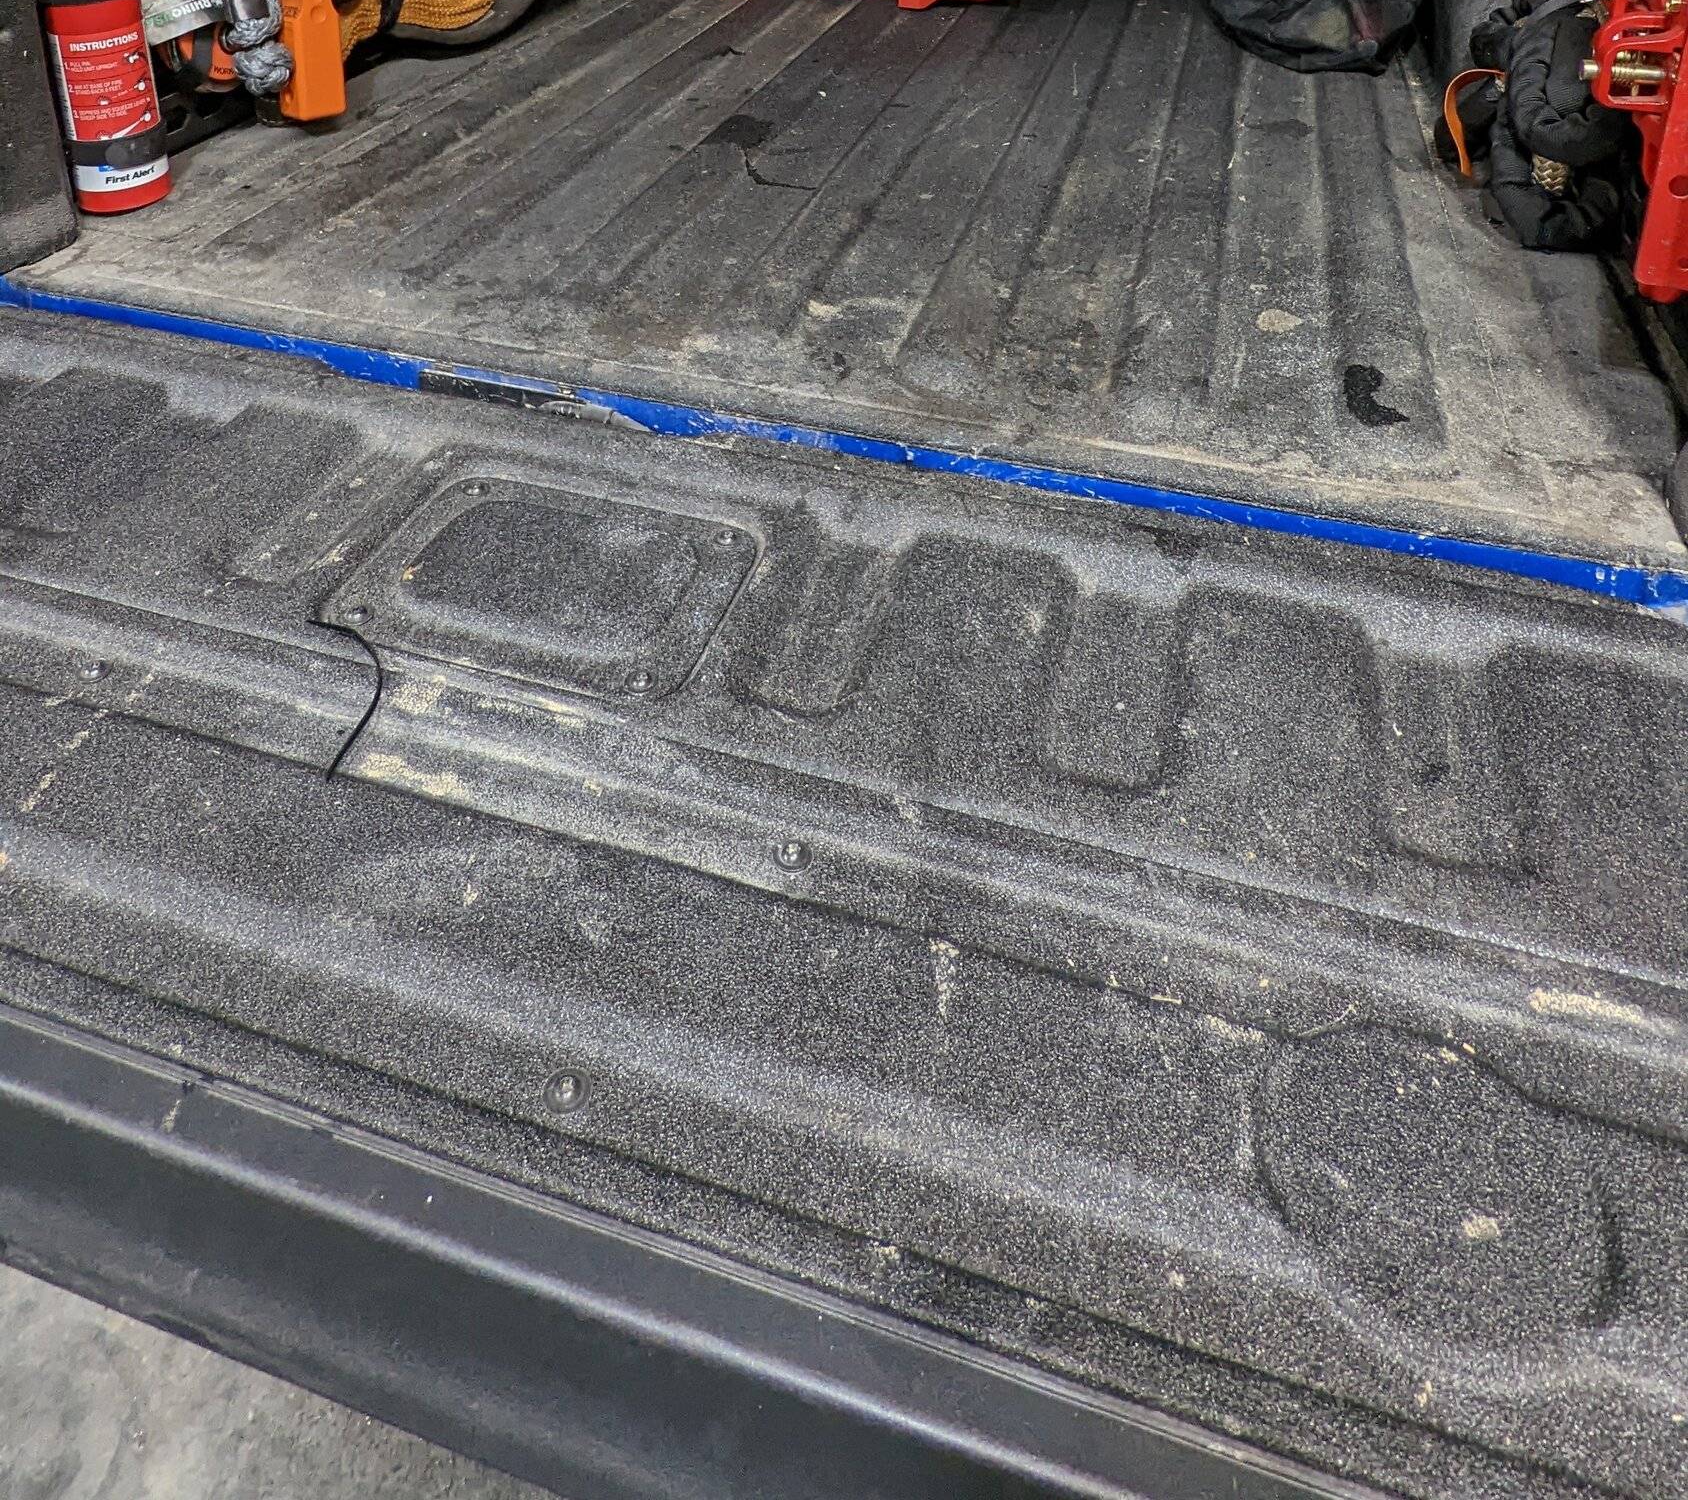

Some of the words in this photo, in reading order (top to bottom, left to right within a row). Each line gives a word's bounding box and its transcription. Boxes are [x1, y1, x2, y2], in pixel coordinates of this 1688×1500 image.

[69, 31, 139, 52] INSTRUCTIONS
[105, 173, 131, 184] First
[131, 165, 155, 180] Alert
